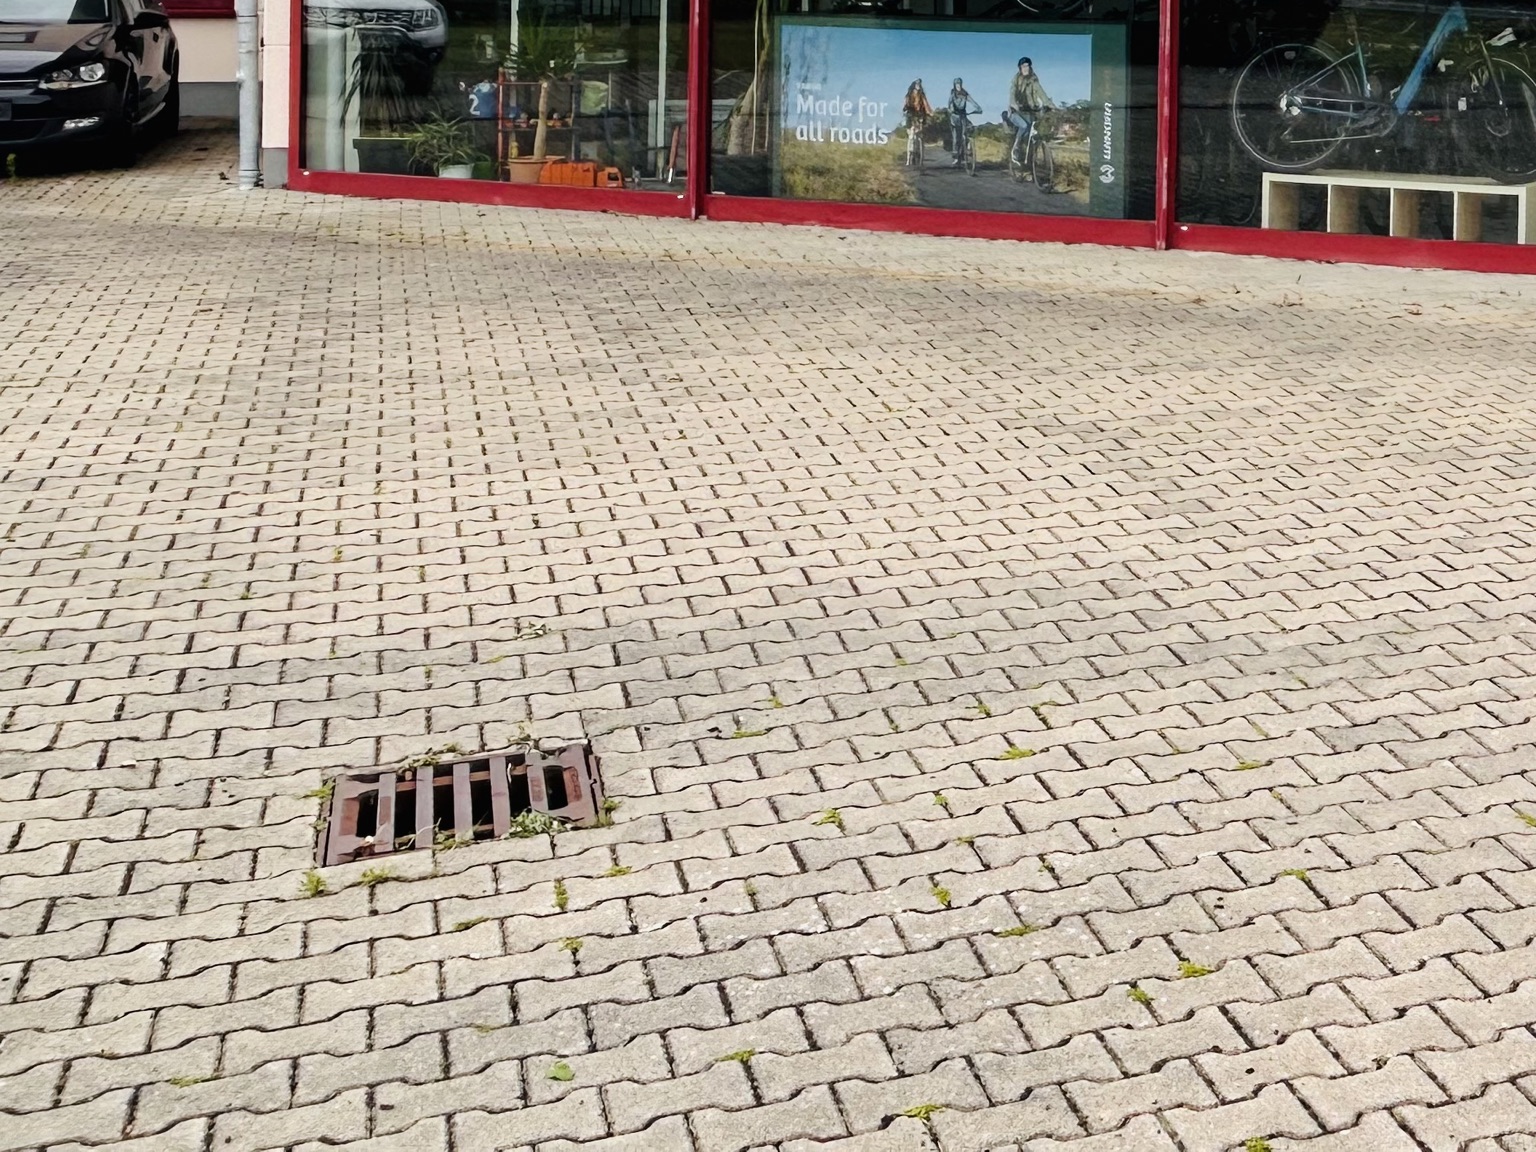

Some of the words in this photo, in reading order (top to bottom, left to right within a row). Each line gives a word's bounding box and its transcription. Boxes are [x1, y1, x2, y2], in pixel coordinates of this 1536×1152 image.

[796, 94, 853, 116] Made
[858, 96, 888, 123] for
[796, 120, 824, 142] all
[830, 122, 889, 145] roads
